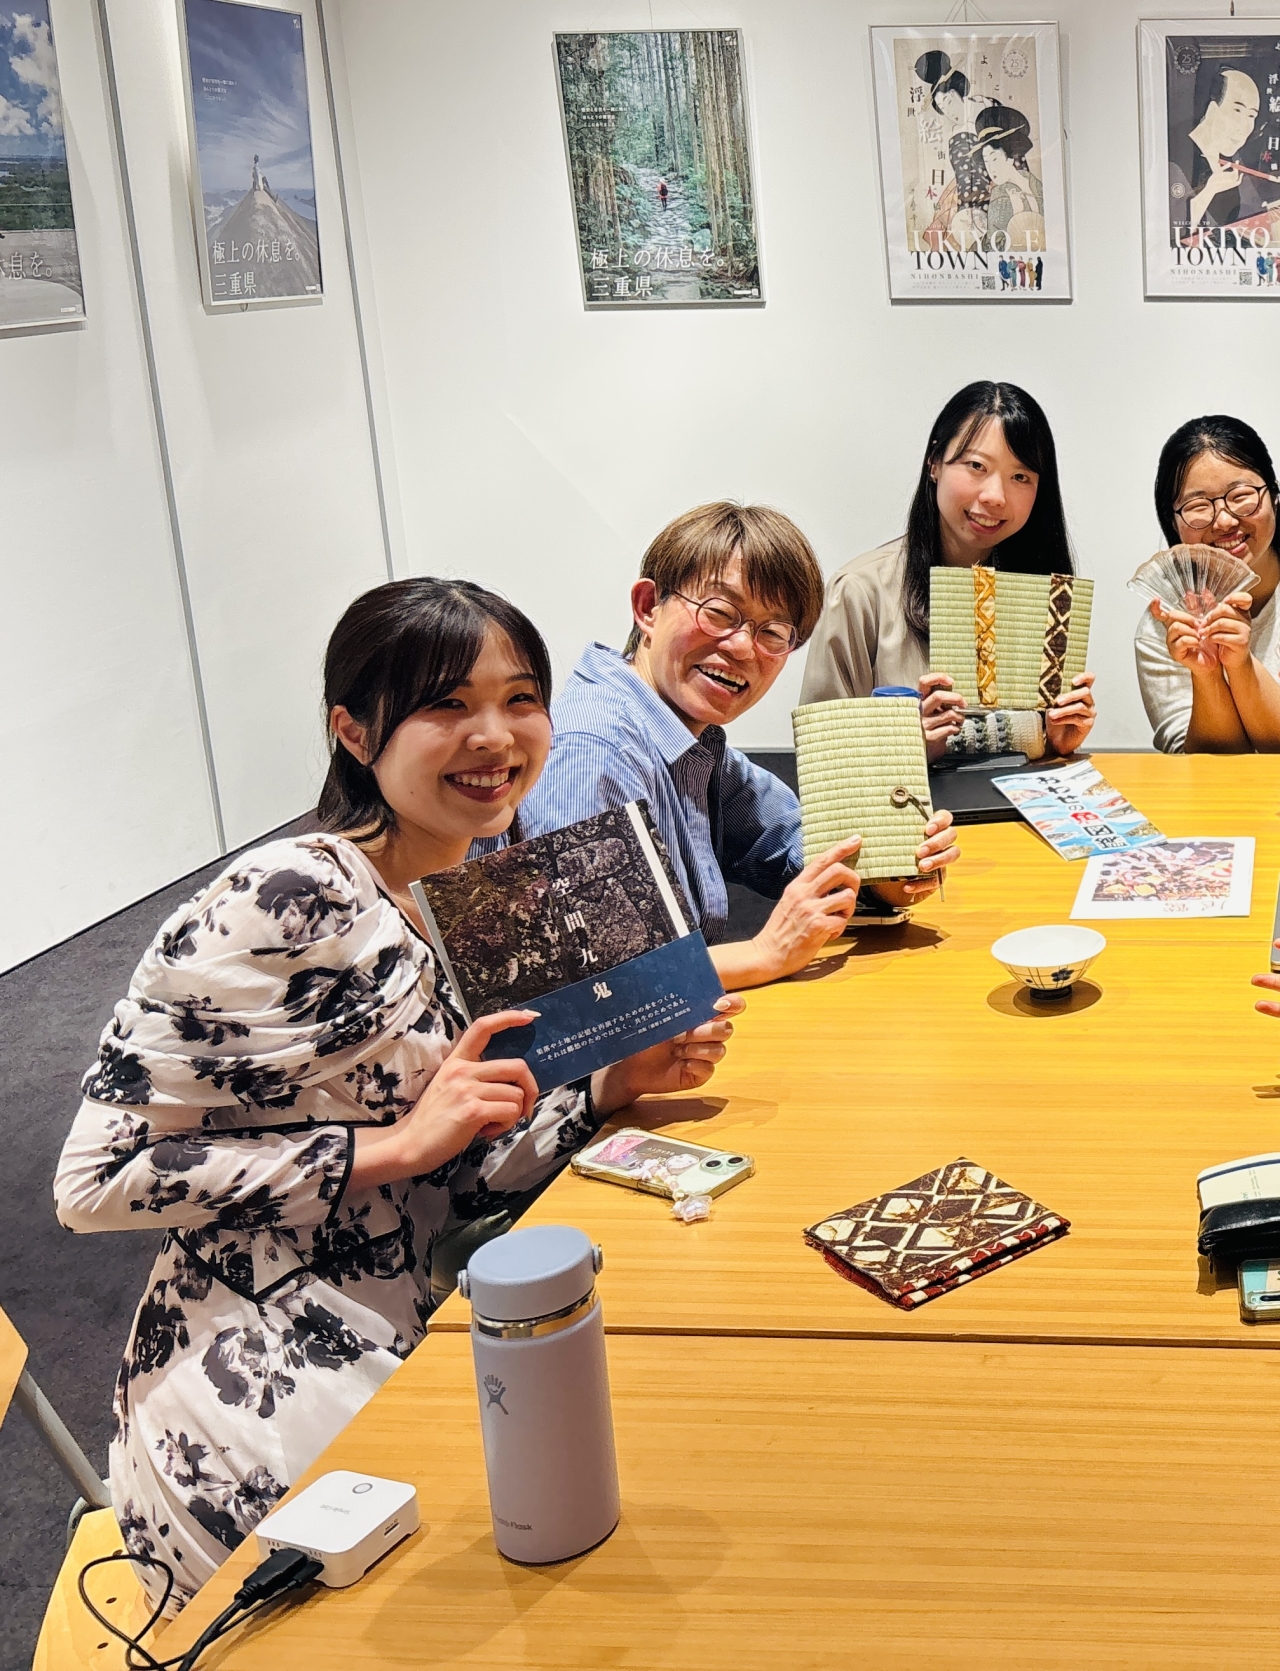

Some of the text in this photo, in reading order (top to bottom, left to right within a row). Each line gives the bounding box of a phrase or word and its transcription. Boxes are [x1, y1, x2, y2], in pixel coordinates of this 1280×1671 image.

[1182, 54, 1192, 64] 25
[212, 239, 301, 264] 極上の休息を。
[911, 229, 1042, 252] UKIYO-E
[589, 247, 725, 270] 極上の休息を。
[910, 250, 989, 271] TOWN
[1170, 246, 1248, 266] TOWN
[214, 271, 257, 296] 三重県
[591, 275, 653, 298] 三重県
